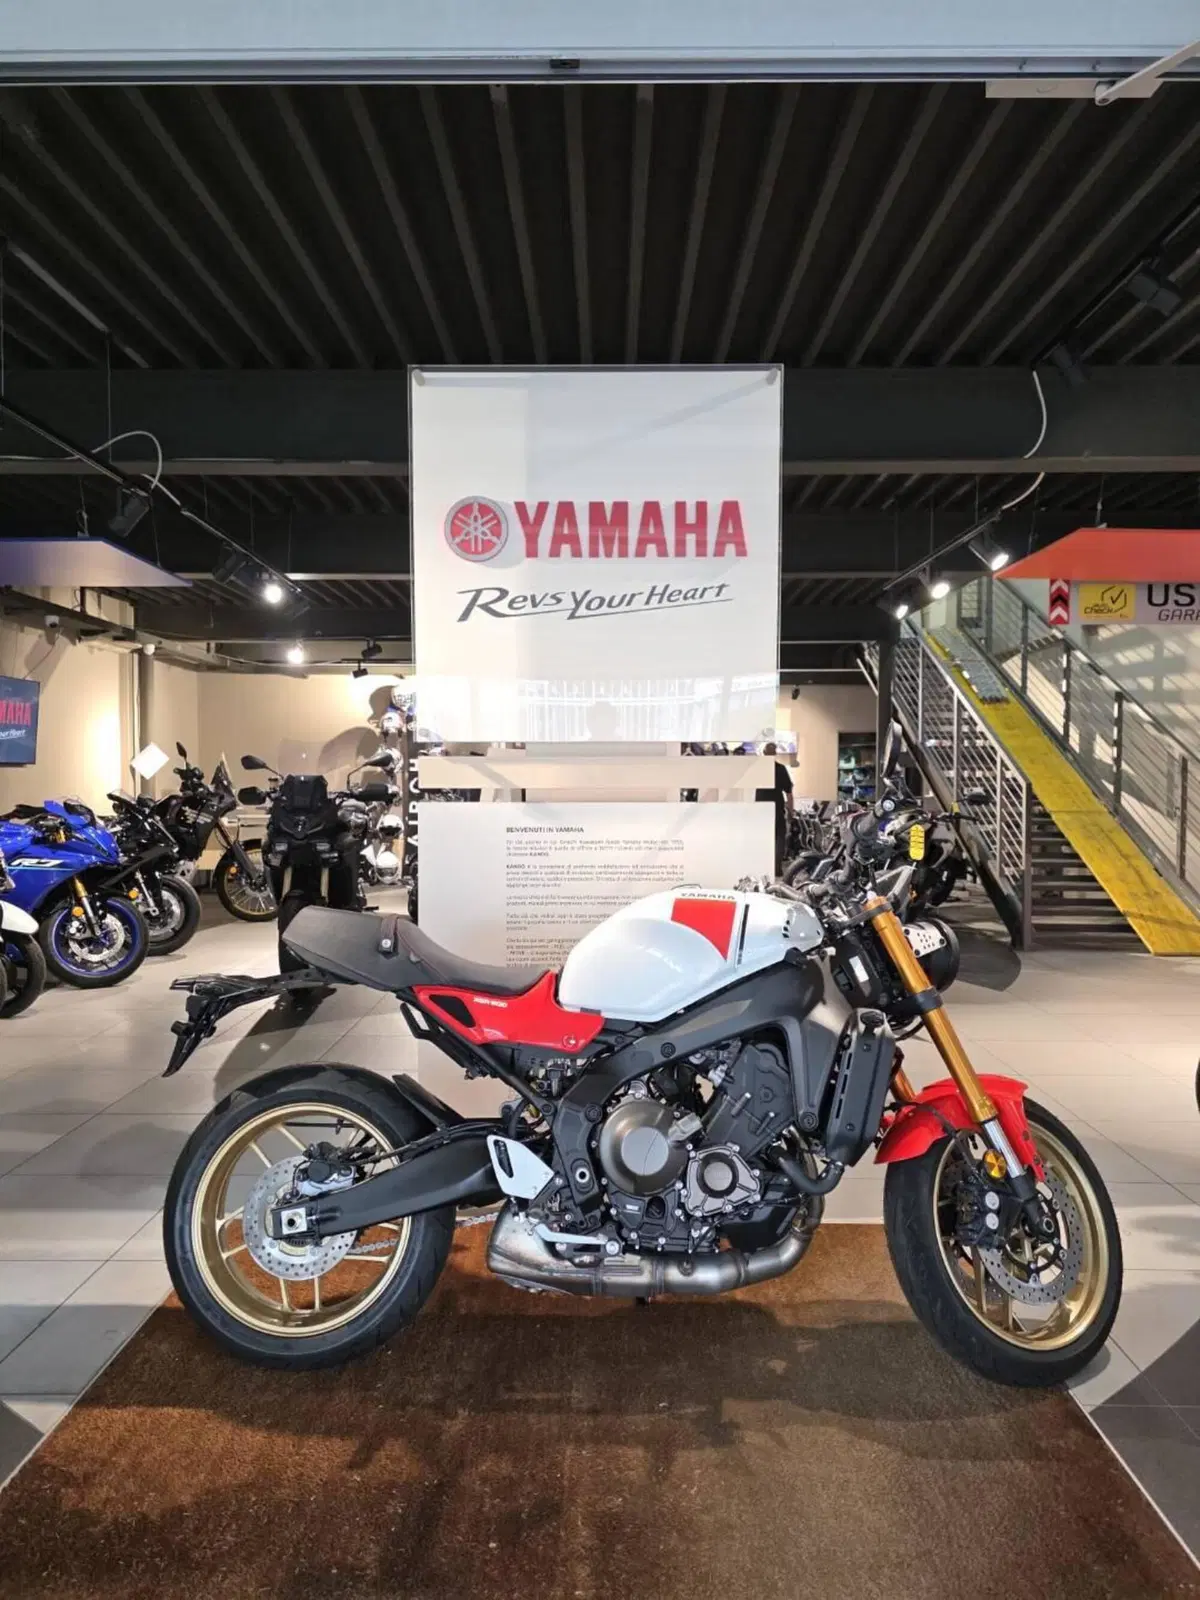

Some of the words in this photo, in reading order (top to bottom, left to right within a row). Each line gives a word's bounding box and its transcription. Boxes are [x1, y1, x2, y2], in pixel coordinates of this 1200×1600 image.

[513, 500, 748, 558] YAMAHA
[456, 586, 566, 622] Revs
[566, 589, 643, 620] Your
[643, 582, 731, 606] Heart
[681, 892, 736, 900] YAMAHA
